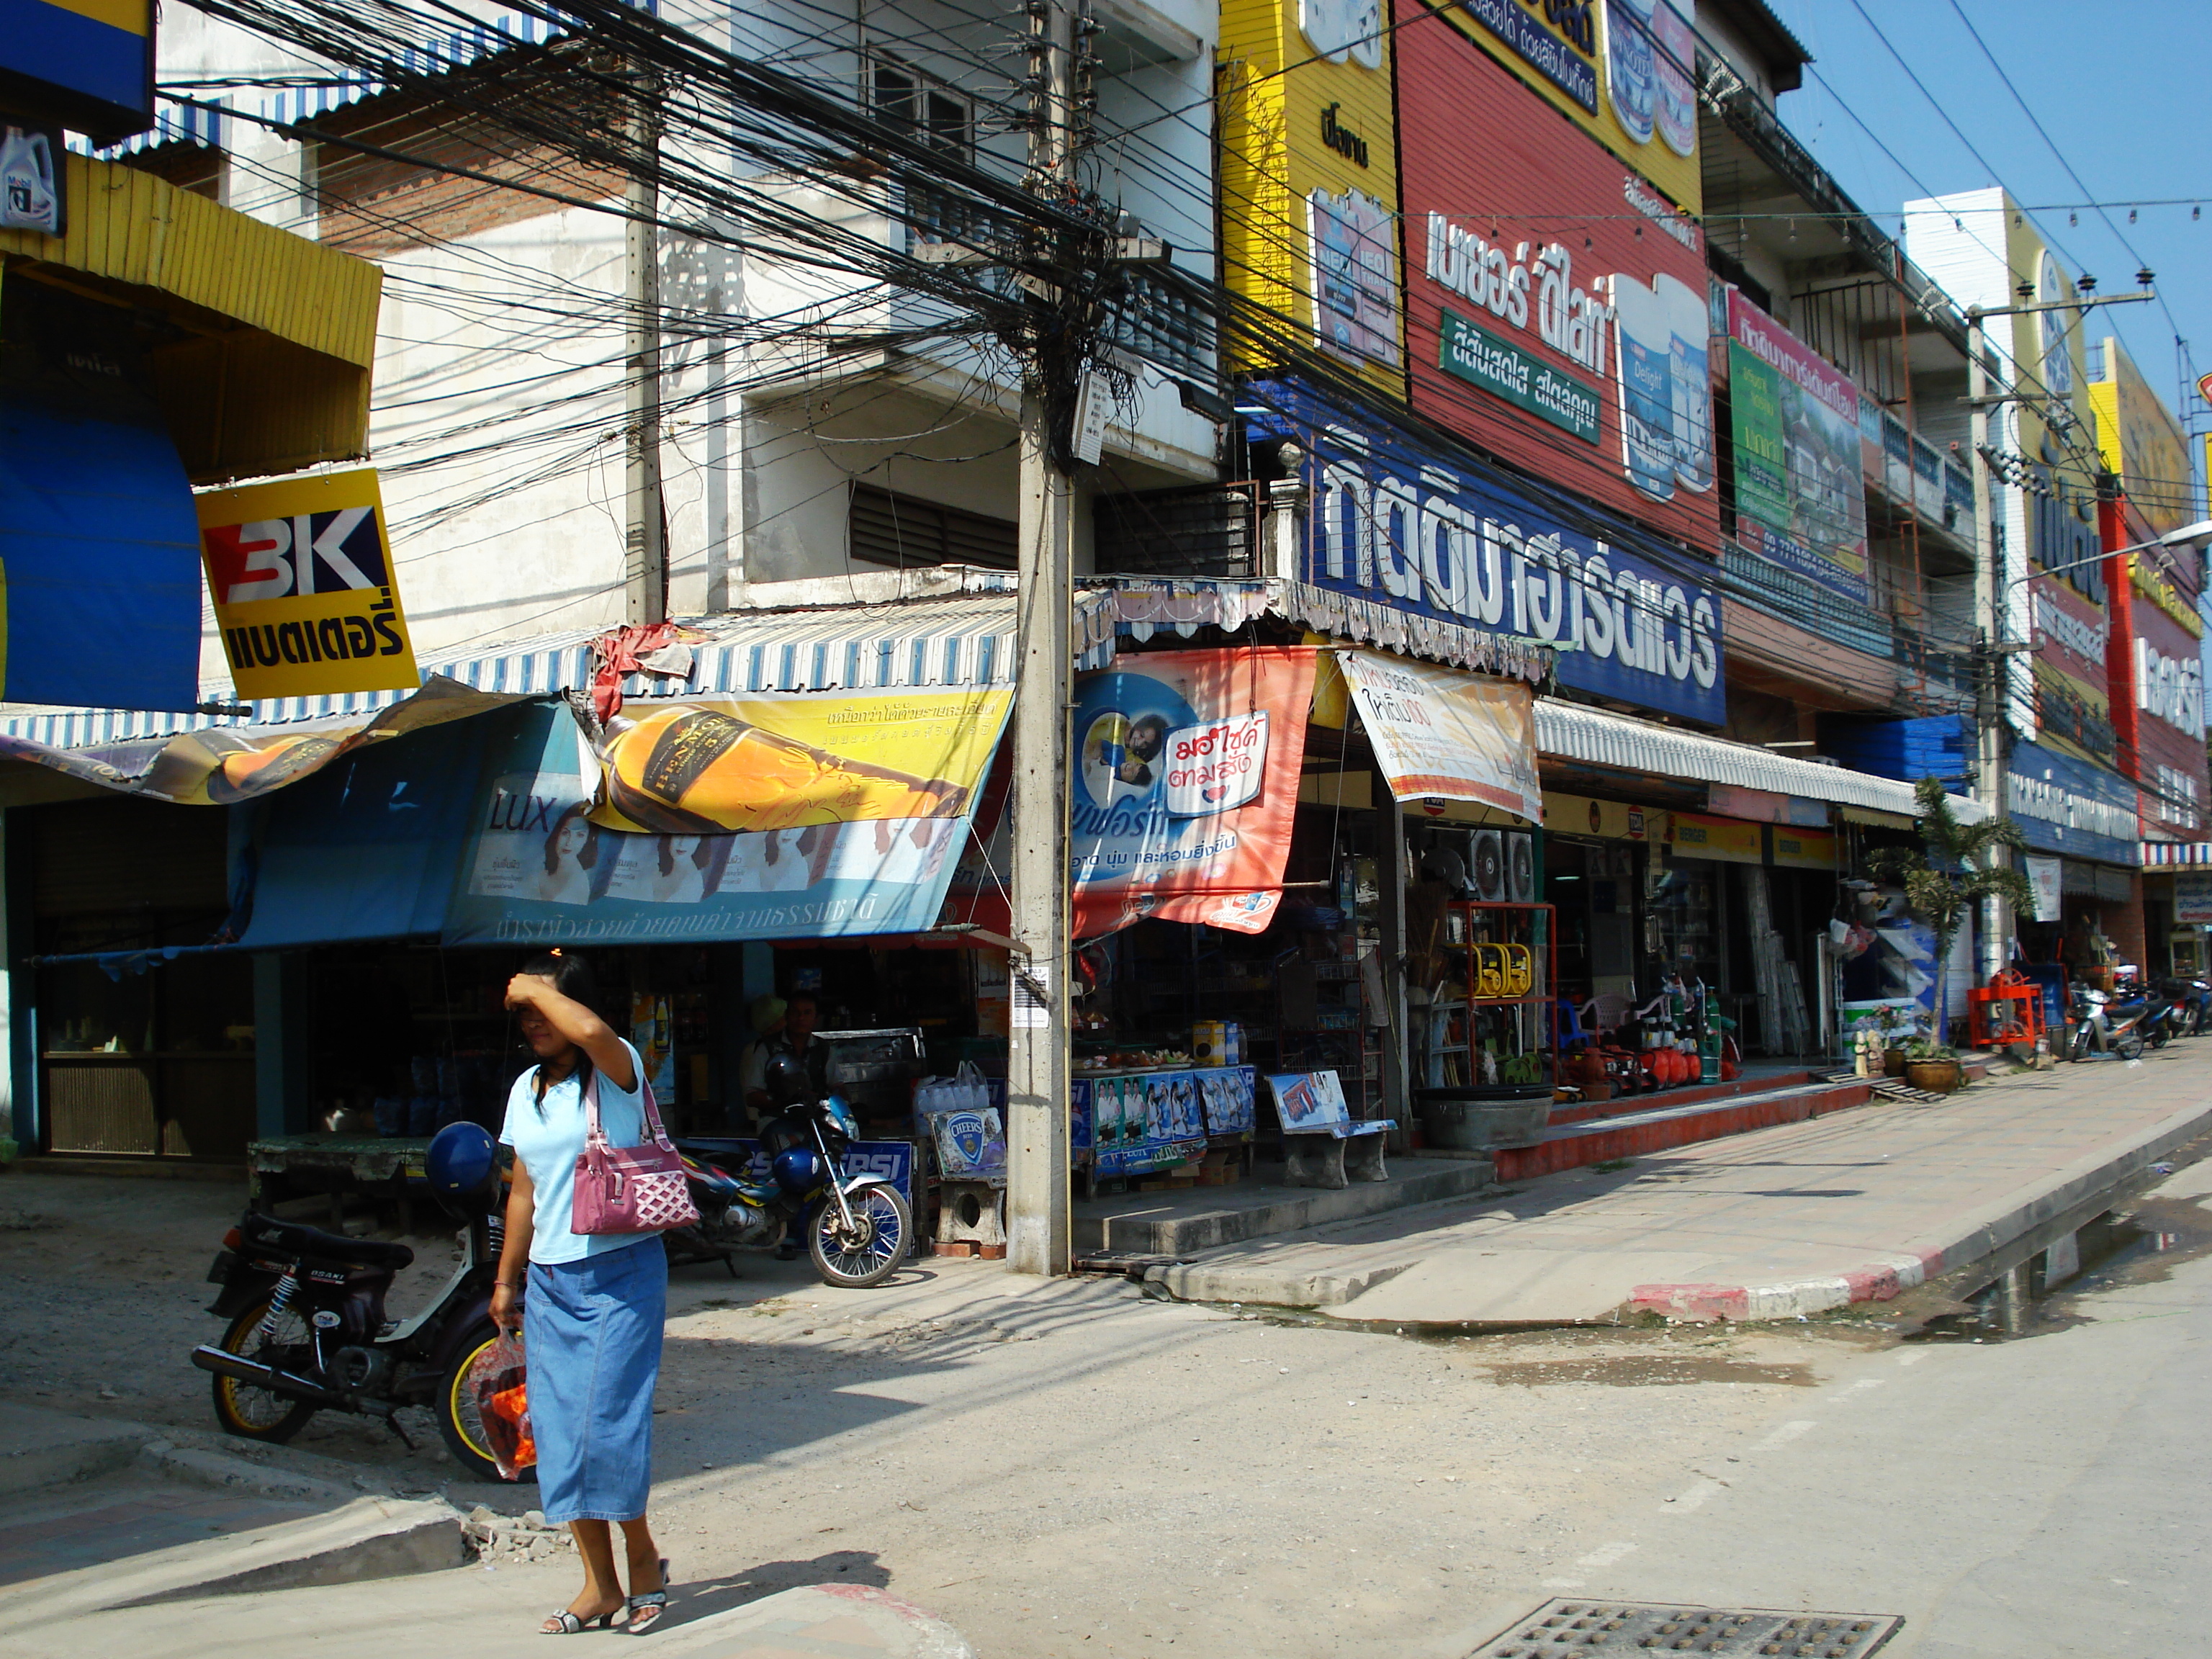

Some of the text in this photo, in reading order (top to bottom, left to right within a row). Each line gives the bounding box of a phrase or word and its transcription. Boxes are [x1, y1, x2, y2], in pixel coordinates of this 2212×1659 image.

[1426, 210, 1530, 329] เบเยอร์
[1635, 361, 1662, 391] Delight
[226, 505, 377, 604] 3K
[1322, 423, 1717, 689] กิตติมาฮาร์ดแวร์
[225, 587, 403, 669] แบตเตอรี่
[1168, 750, 1251, 788] ตามสั่ง
[489, 793, 557, 833] LUX
[1629, 814, 1643, 829] TOA
[1679, 827, 1707, 843] BERGER
[1107, 849, 1129, 870] นุ่ม
[950, 1120, 983, 1138] CHEERS
[311, 1269, 346, 1281] OSAKI
